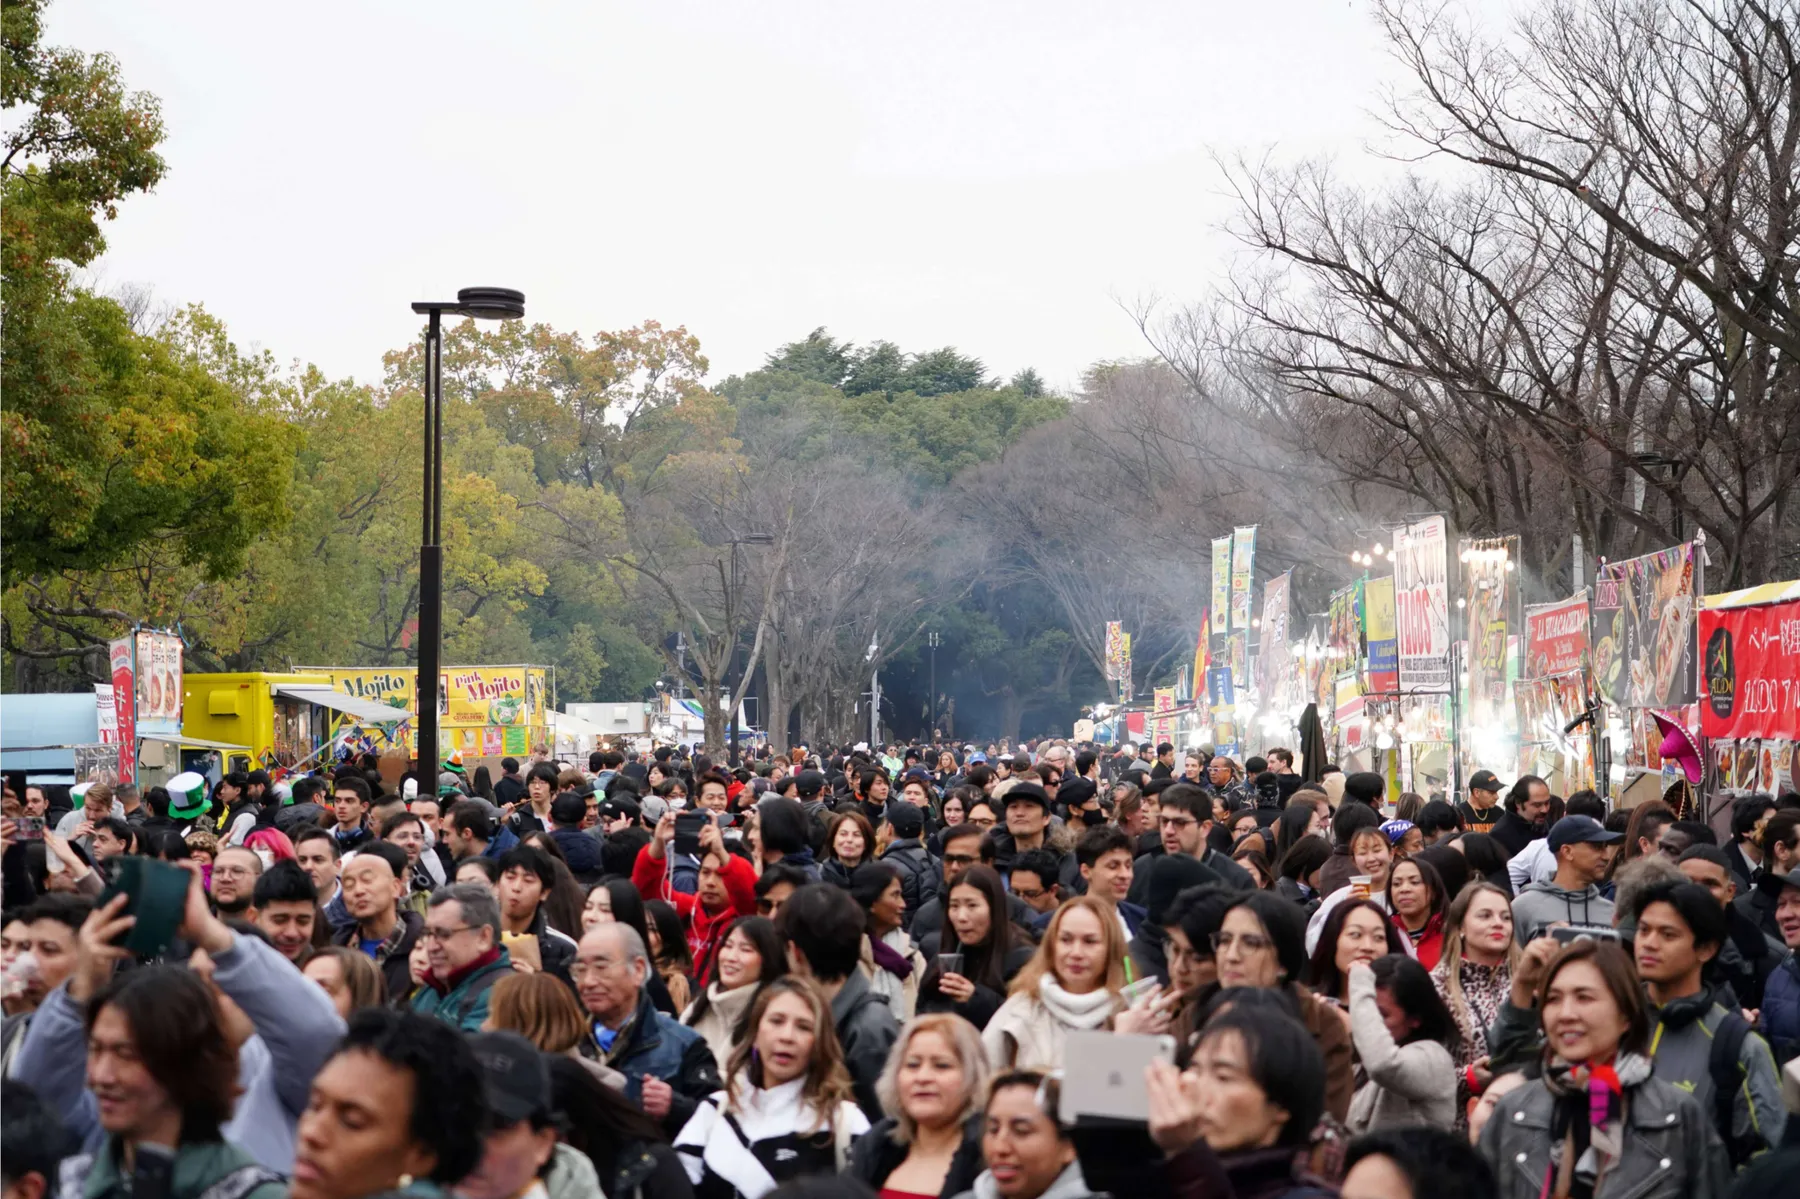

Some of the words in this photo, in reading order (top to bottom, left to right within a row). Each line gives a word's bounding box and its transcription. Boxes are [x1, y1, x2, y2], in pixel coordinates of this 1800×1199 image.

[1397, 588, 1431, 656] TACOS
[1749, 619, 1800, 656] ペルー料理
[343, 674, 405, 701] Mojito
[455, 671, 481, 688] Pink
[468, 677, 521, 701] Mojito
[1743, 678, 1778, 713] ALDO
